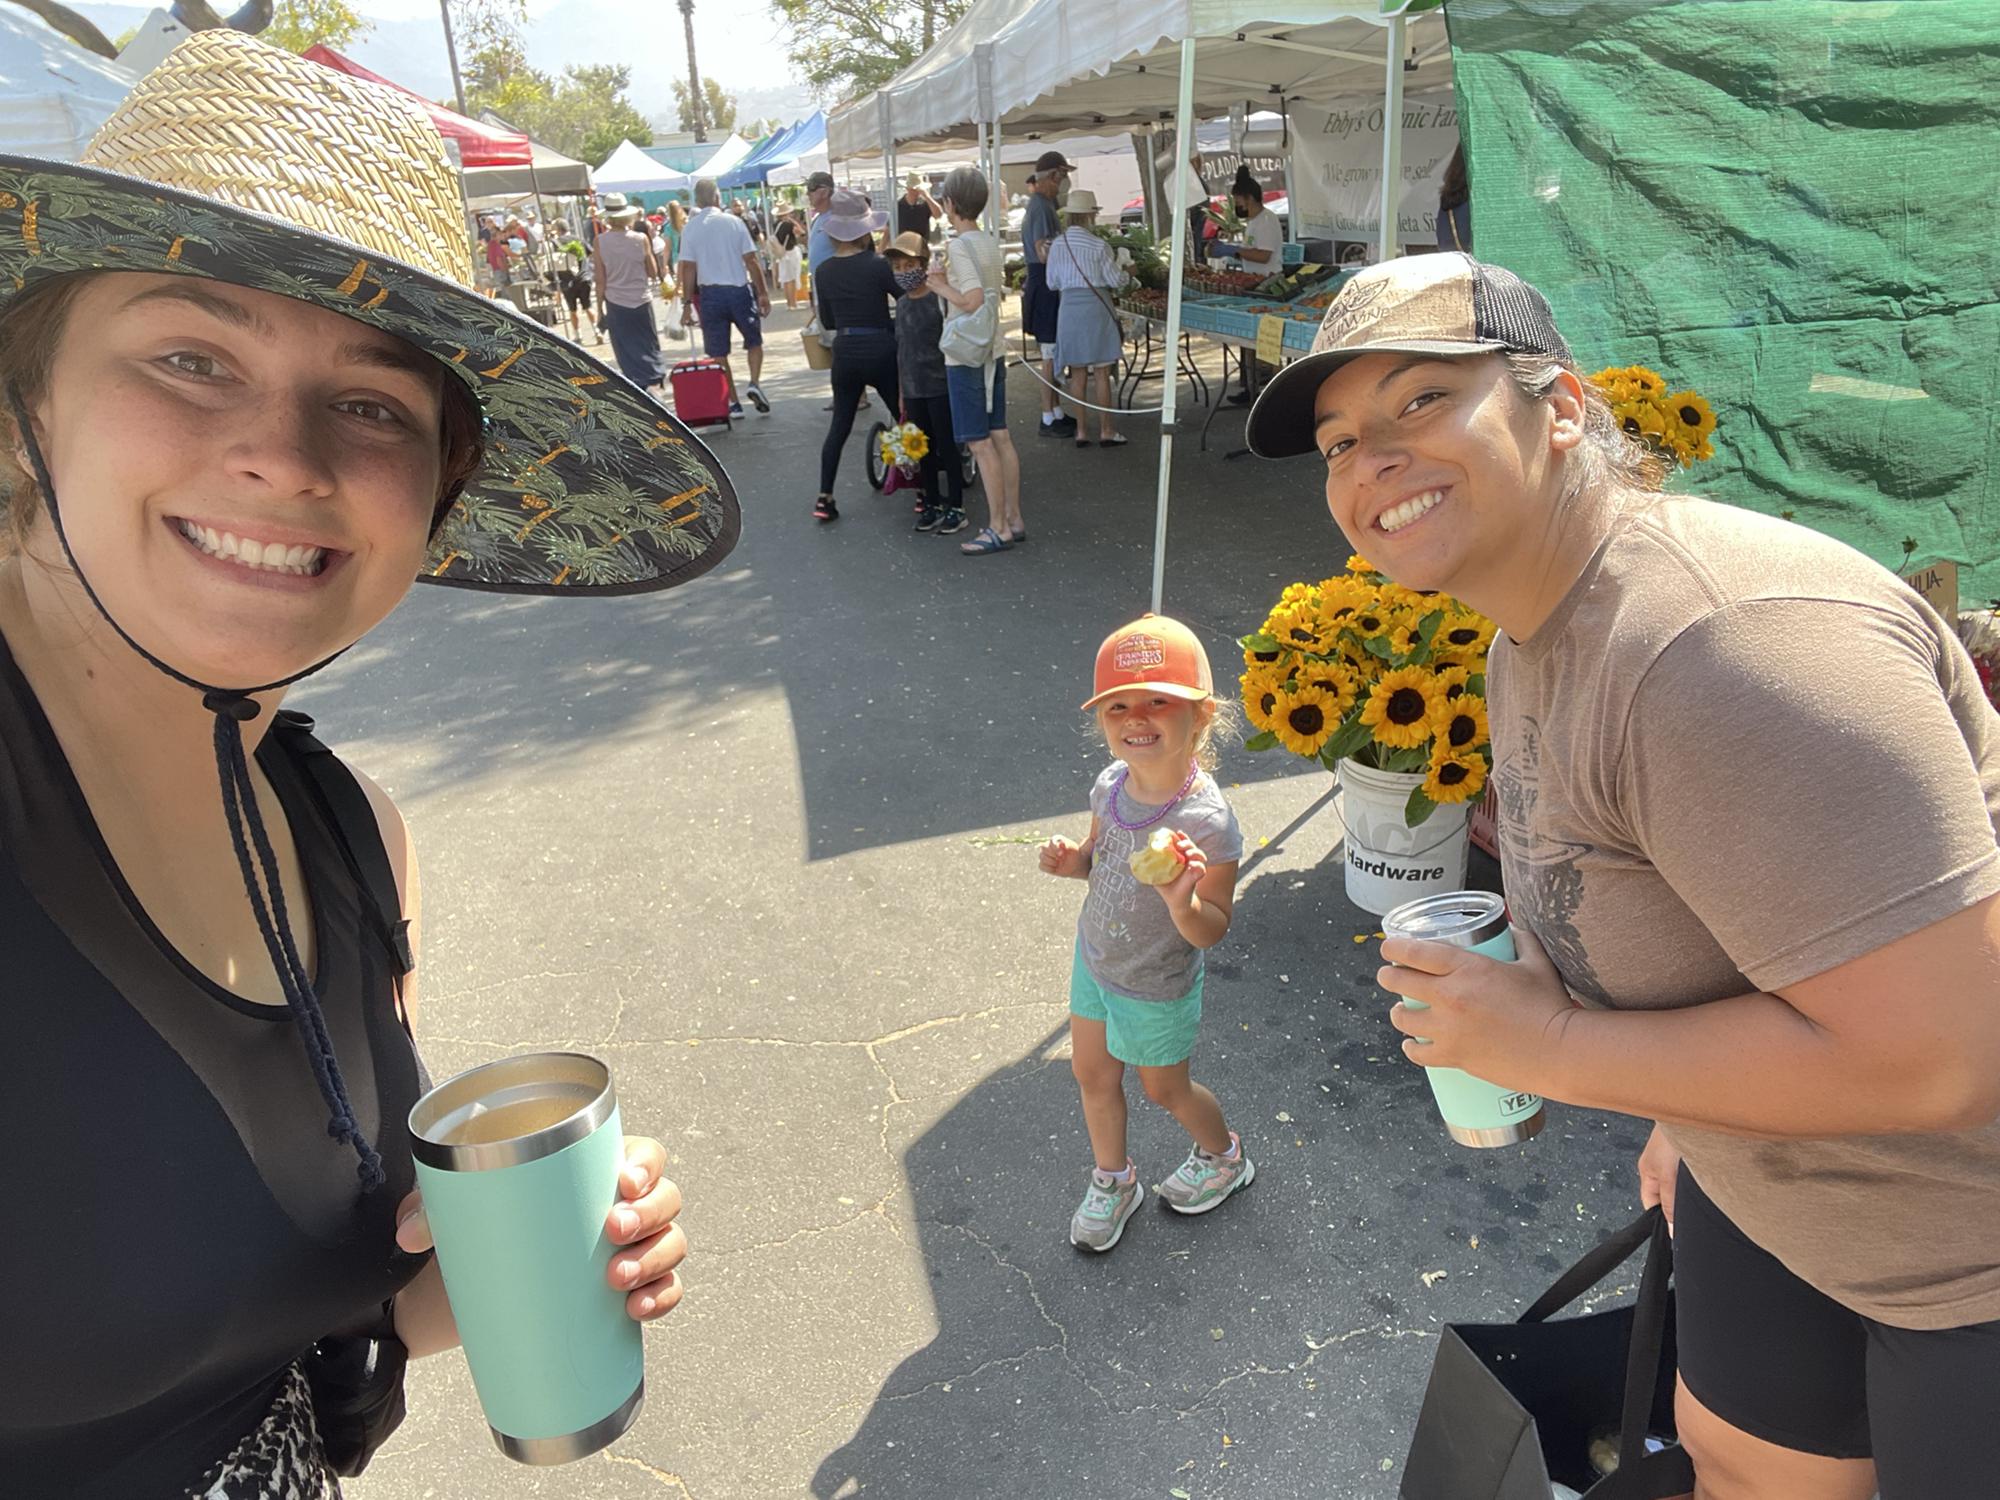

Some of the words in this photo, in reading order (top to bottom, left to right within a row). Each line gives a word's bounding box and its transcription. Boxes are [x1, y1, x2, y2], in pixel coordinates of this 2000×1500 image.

[1323, 110, 1365, 140] Ebby's
[1367, 105, 1430, 132] Onic
[1431, 103, 1458, 129] Far
[1342, 167, 1371, 188] grow
[1397, 211, 1421, 233] leta
[1346, 845, 1446, 882] Hardware
[1503, 1092, 1537, 1111] YET
